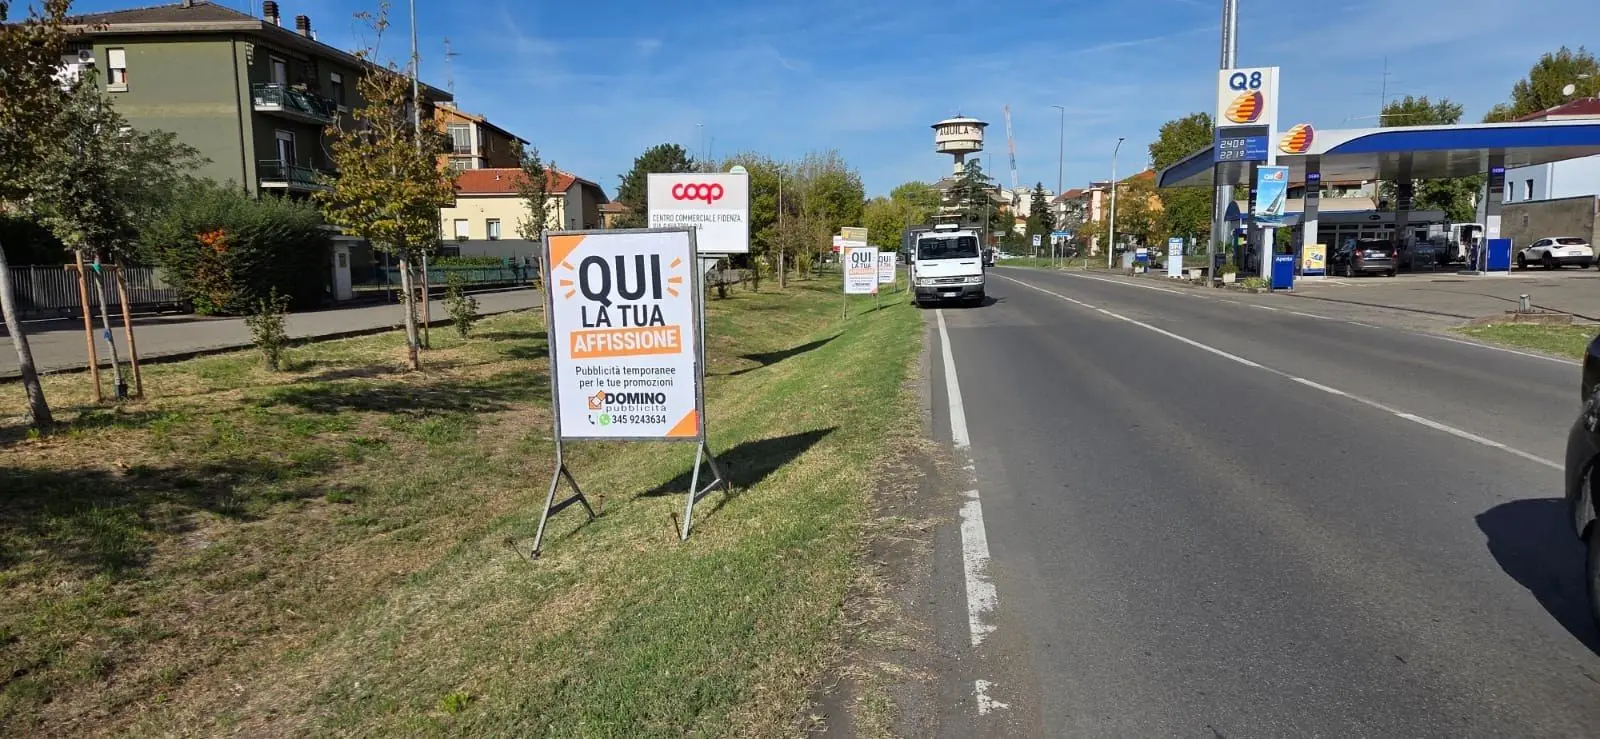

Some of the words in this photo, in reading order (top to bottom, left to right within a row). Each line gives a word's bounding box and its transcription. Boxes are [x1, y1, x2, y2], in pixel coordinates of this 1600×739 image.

[1229, 71, 1262, 90] Q8
[940, 124, 969, 136] AQUILA
[672, 183, 724, 205] coop
[652, 213, 674, 222] CENTRO
[676, 213, 715, 222] COMMERCIALE
[851, 251, 872, 264] QUI
[579, 254, 663, 308] QUI
[582, 305, 612, 328] LA
[617, 304, 666, 327] TUA
[574, 329, 678, 352] AFFISSIONE
[575, 366, 620, 376] Pubblicità
[623, 366, 676, 377] temporanee
[579, 379, 593, 389] per
[596, 378, 604, 387] le
[607, 378, 621, 387] tue
[623, 377, 674, 389] promozioni
[605, 393, 666, 404] DOMINO
[605, 404, 667, 413] pubblicità
[612, 415, 627, 424] 345
[630, 414, 666, 424] 9243634
